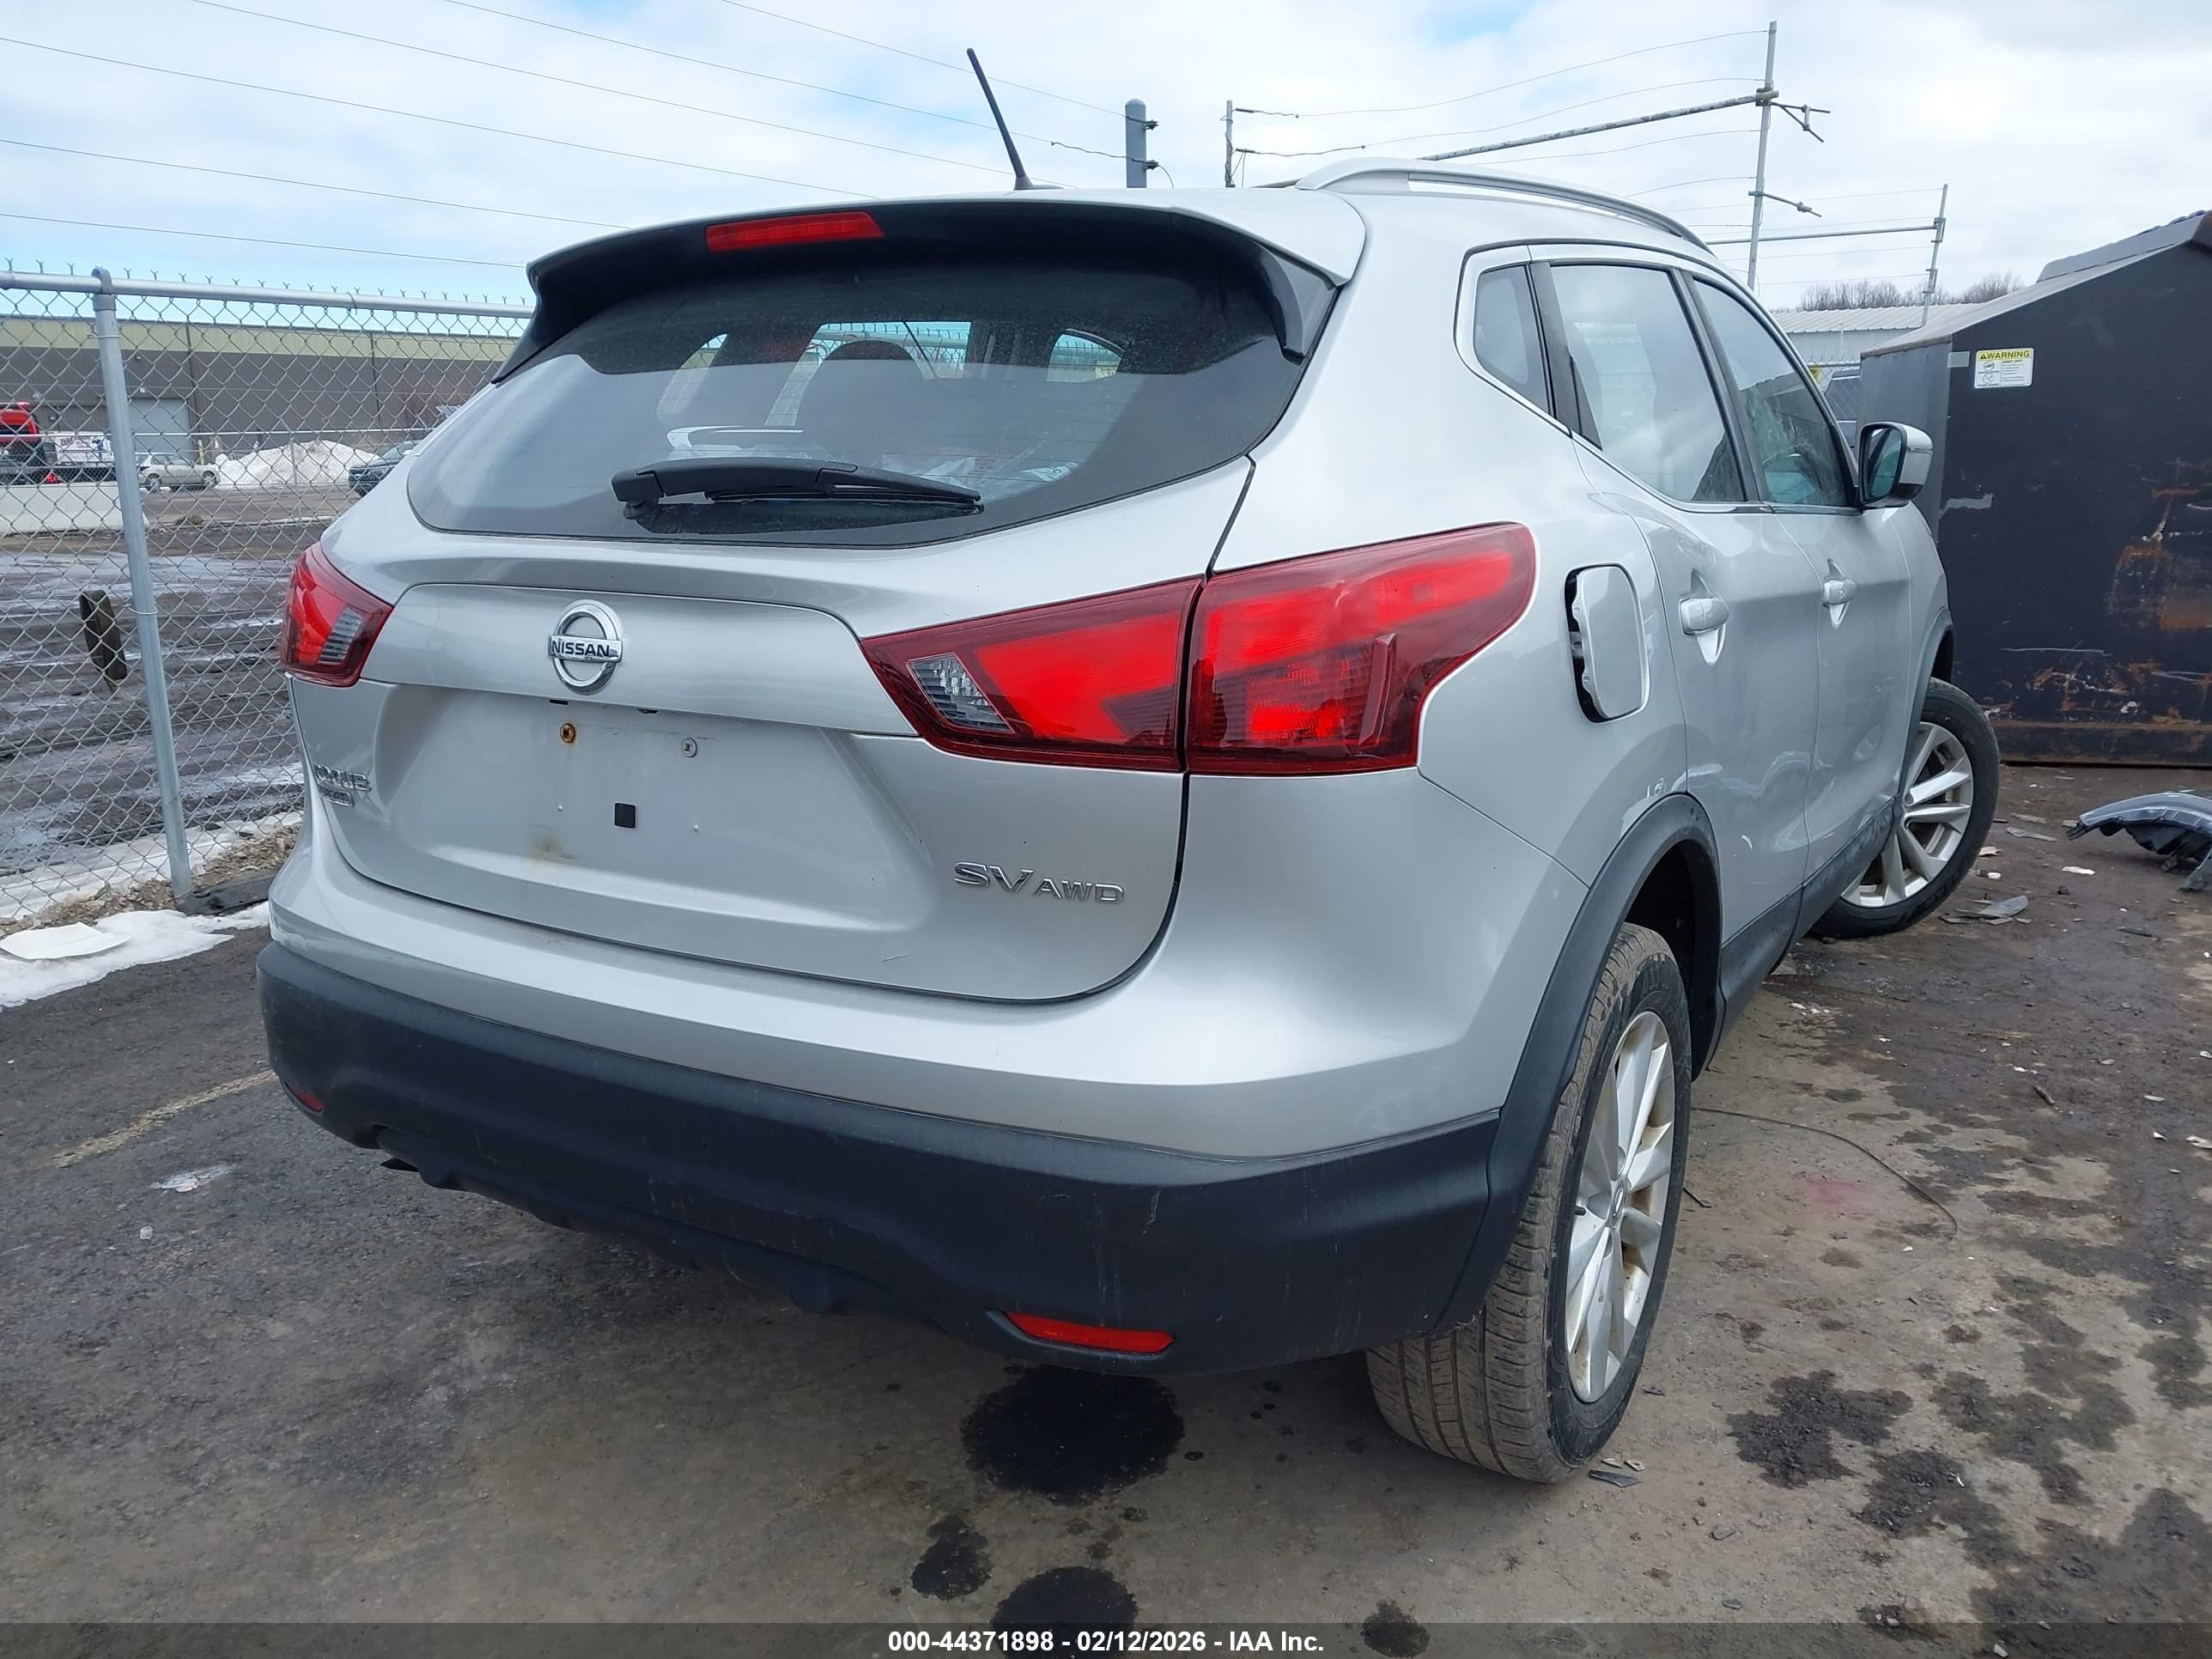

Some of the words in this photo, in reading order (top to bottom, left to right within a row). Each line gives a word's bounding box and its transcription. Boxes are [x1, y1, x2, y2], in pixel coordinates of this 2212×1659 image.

[1987, 350, 2030, 359] WARNING
[551, 640, 611, 658] NISSAN
[954, 860, 1035, 894] SV
[1033, 878, 1125, 904] AWD
